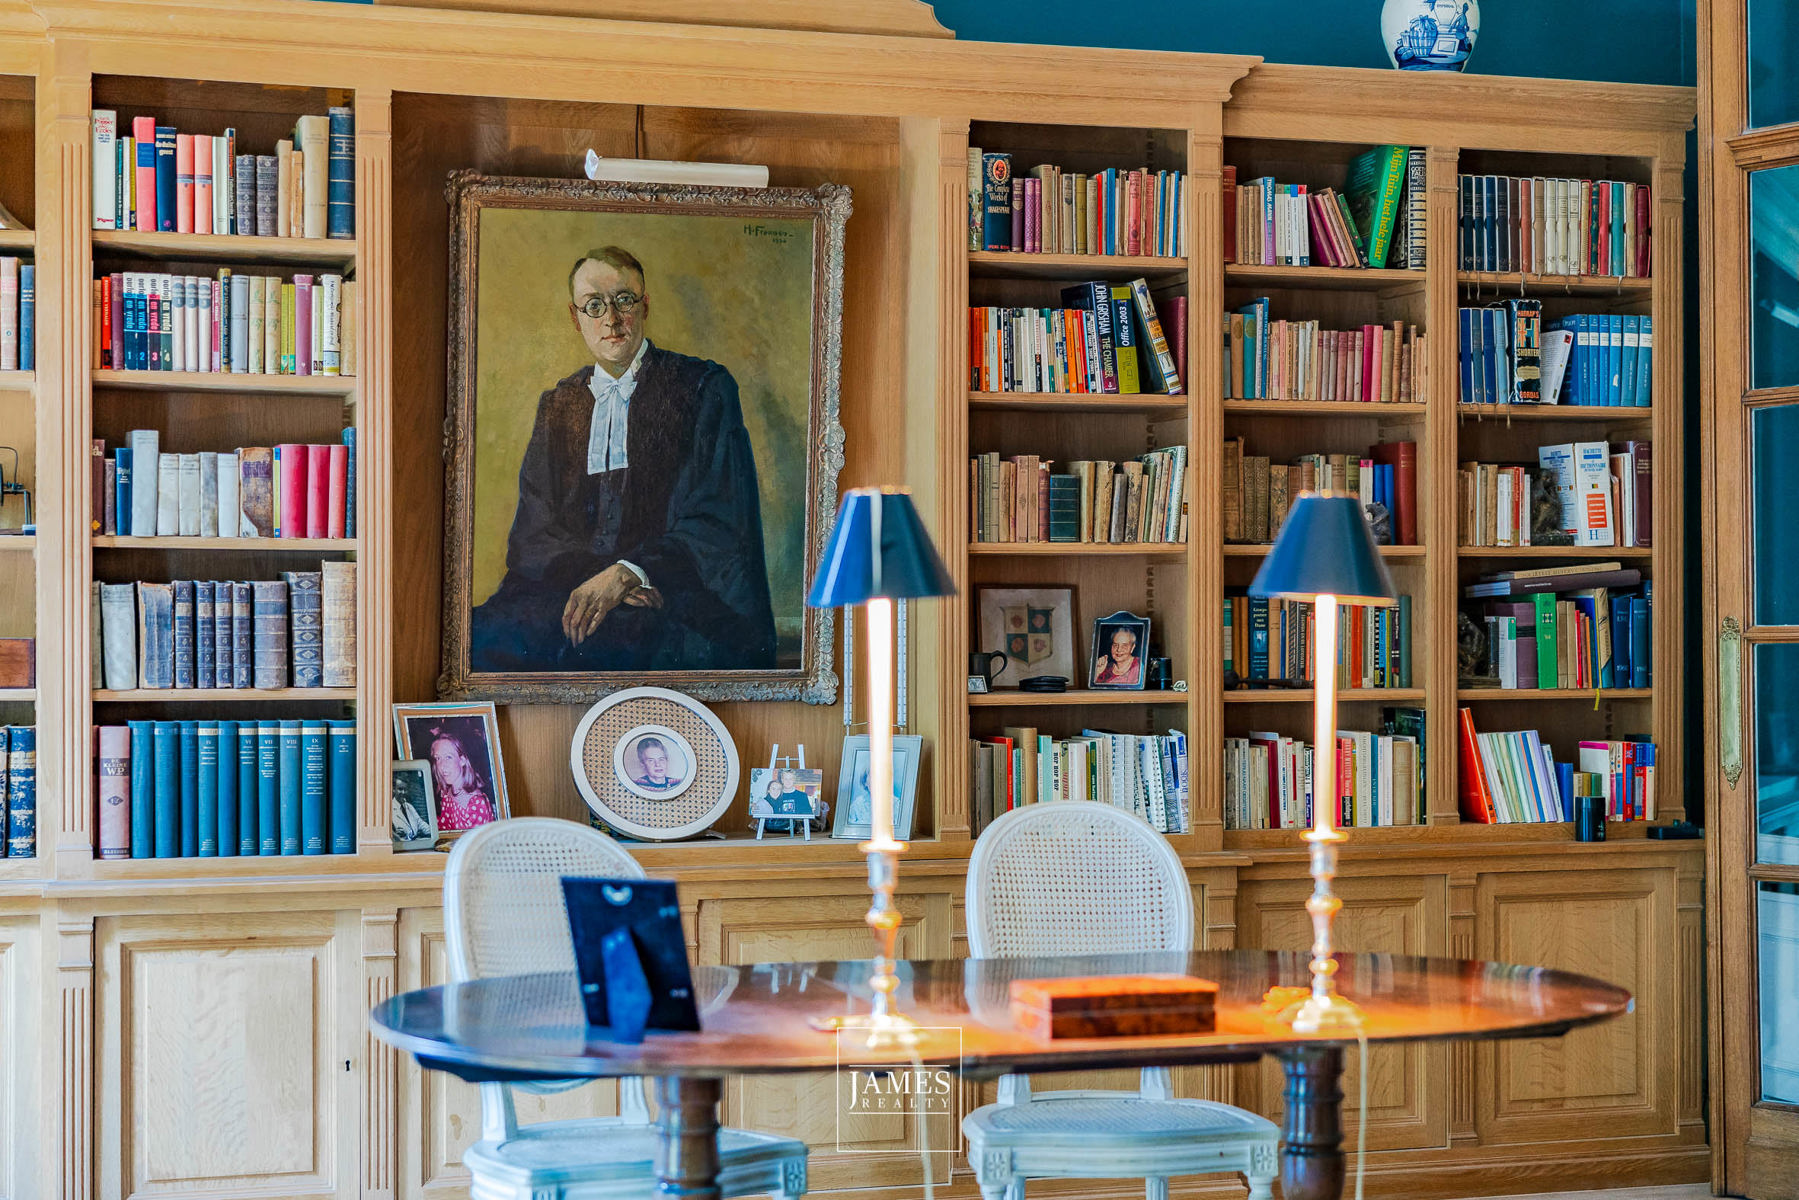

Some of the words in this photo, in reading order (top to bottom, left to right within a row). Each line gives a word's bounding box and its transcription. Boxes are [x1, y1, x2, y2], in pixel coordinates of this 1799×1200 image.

[1390, 146, 1404, 172] Mijn
[1383, 172, 1400, 198] Tuin,
[1382, 199, 1395, 215] het
[1377, 217, 1391, 238] hele
[1374, 238, 1388, 260] jaar
[126, 277, 136, 298] oorlog
[138, 278, 147, 299] oorlog
[150, 278, 159, 299] oorlog
[162, 279, 171, 300] oorlog
[1094, 284, 1108, 304] JOHN
[126, 300, 133, 308] en
[138, 300, 145, 309] en
[150, 301, 158, 310] en
[162, 301, 170, 310] en
[126, 310, 135, 329] vrede
[138, 311, 147, 330] vrede
[150, 312, 158, 331] vrede
[162, 312, 171, 331] vrede
[1097, 303, 1112, 335] GRISHAM
[1119, 306, 1128, 326] 2003
[1101, 336, 1111, 349] THE
[1121, 328, 1130, 347] Office
[128, 351, 132, 360] 1
[139, 351, 145, 361] 2
[152, 352, 158, 361] 3
[164, 352, 170, 362] 4
[1517, 348, 1540, 357] SHORTER
[1103, 350, 1114, 378] CHAMBER
